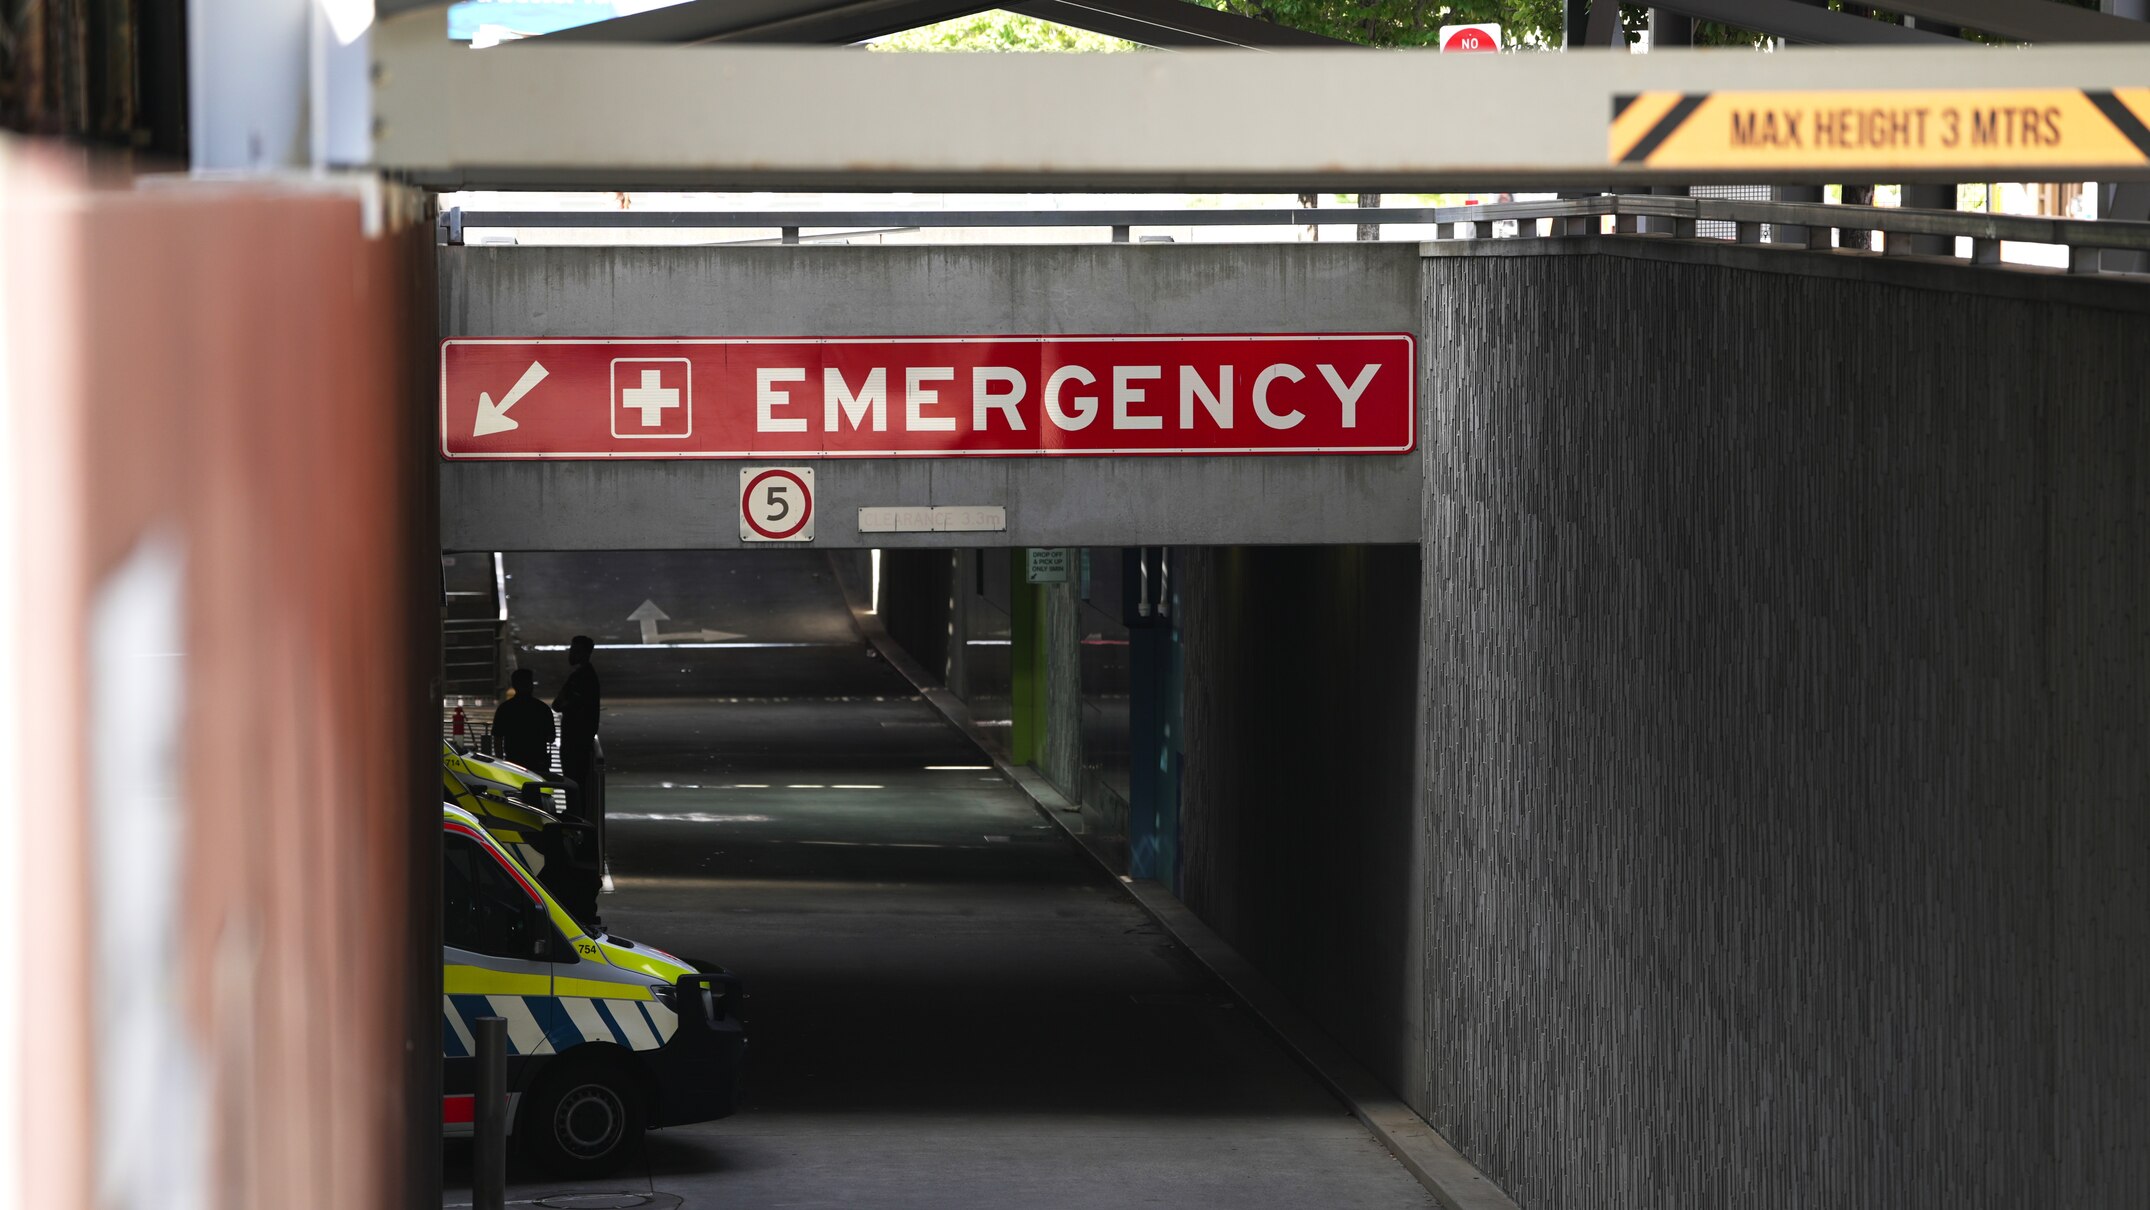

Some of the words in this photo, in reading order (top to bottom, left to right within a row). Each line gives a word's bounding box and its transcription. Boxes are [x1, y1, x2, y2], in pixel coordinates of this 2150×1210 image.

[1461, 37, 1479, 50] NO
[1731, 109, 1800, 147] MAX
[1815, 109, 1932, 147] HEIGHT
[1940, 108, 1961, 147] 3
[1971, 107, 2062, 147] MTRS
[756, 363, 1382, 433] EMERGENCY
[766, 486, 789, 522] 5
[864, 512, 953, 527] CLEARANCE
[578, 944, 597, 954] 754
